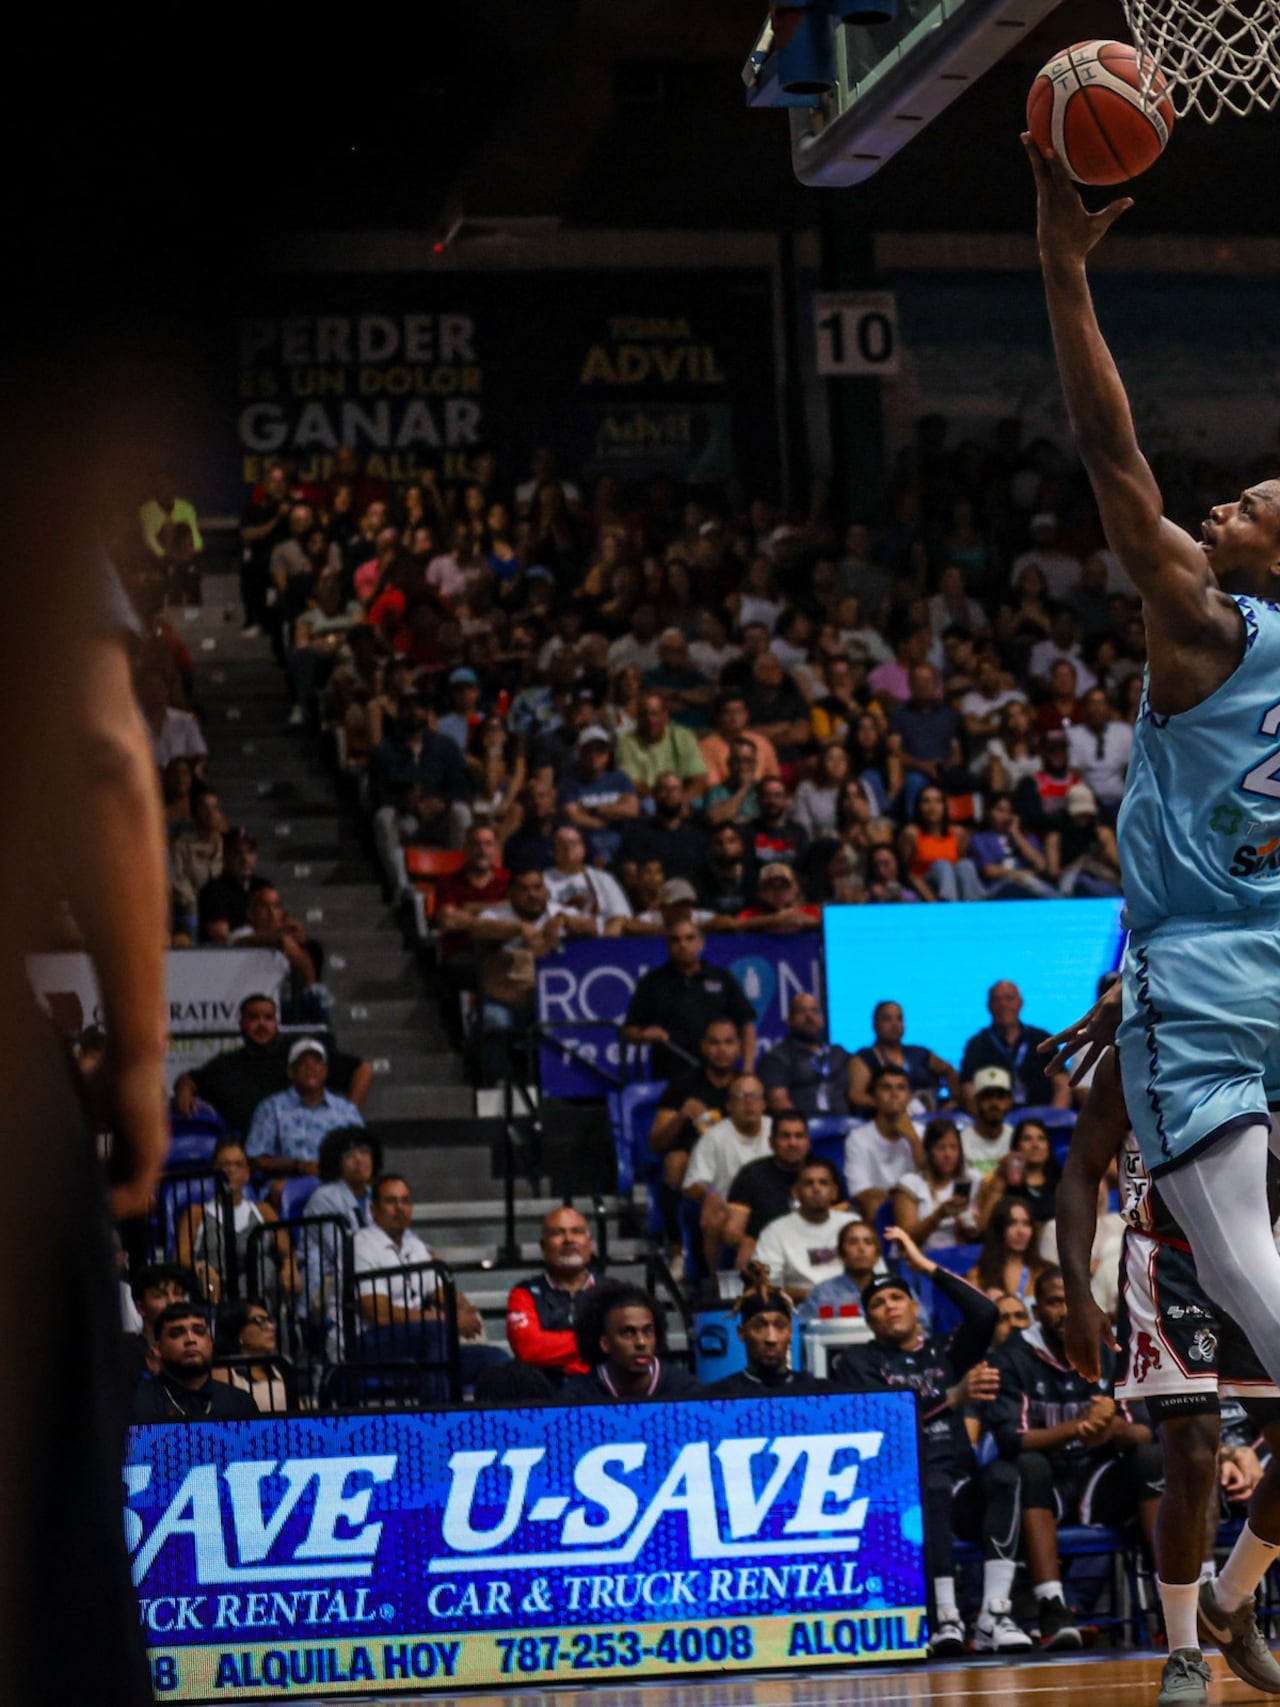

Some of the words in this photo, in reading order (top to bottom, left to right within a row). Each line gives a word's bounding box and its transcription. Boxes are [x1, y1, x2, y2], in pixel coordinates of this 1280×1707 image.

[238, 312, 479, 366] PERDER
[821, 311, 894, 363] 10
[358, 367, 482, 396] DOLOR
[578, 344, 724, 385] ADVIL
[237, 401, 483, 452] GANAR
[440, 1431, 884, 1562] U-SAVE
[427, 1578, 512, 1619] CAR
[521, 1576, 553, 1614] &
[563, 1569, 700, 1614] TRUCK
[213, 1646, 375, 1691] ALQUILA
[384, 1641, 462, 1680] HOY
[495, 1624, 754, 1675] 787-253-4008
